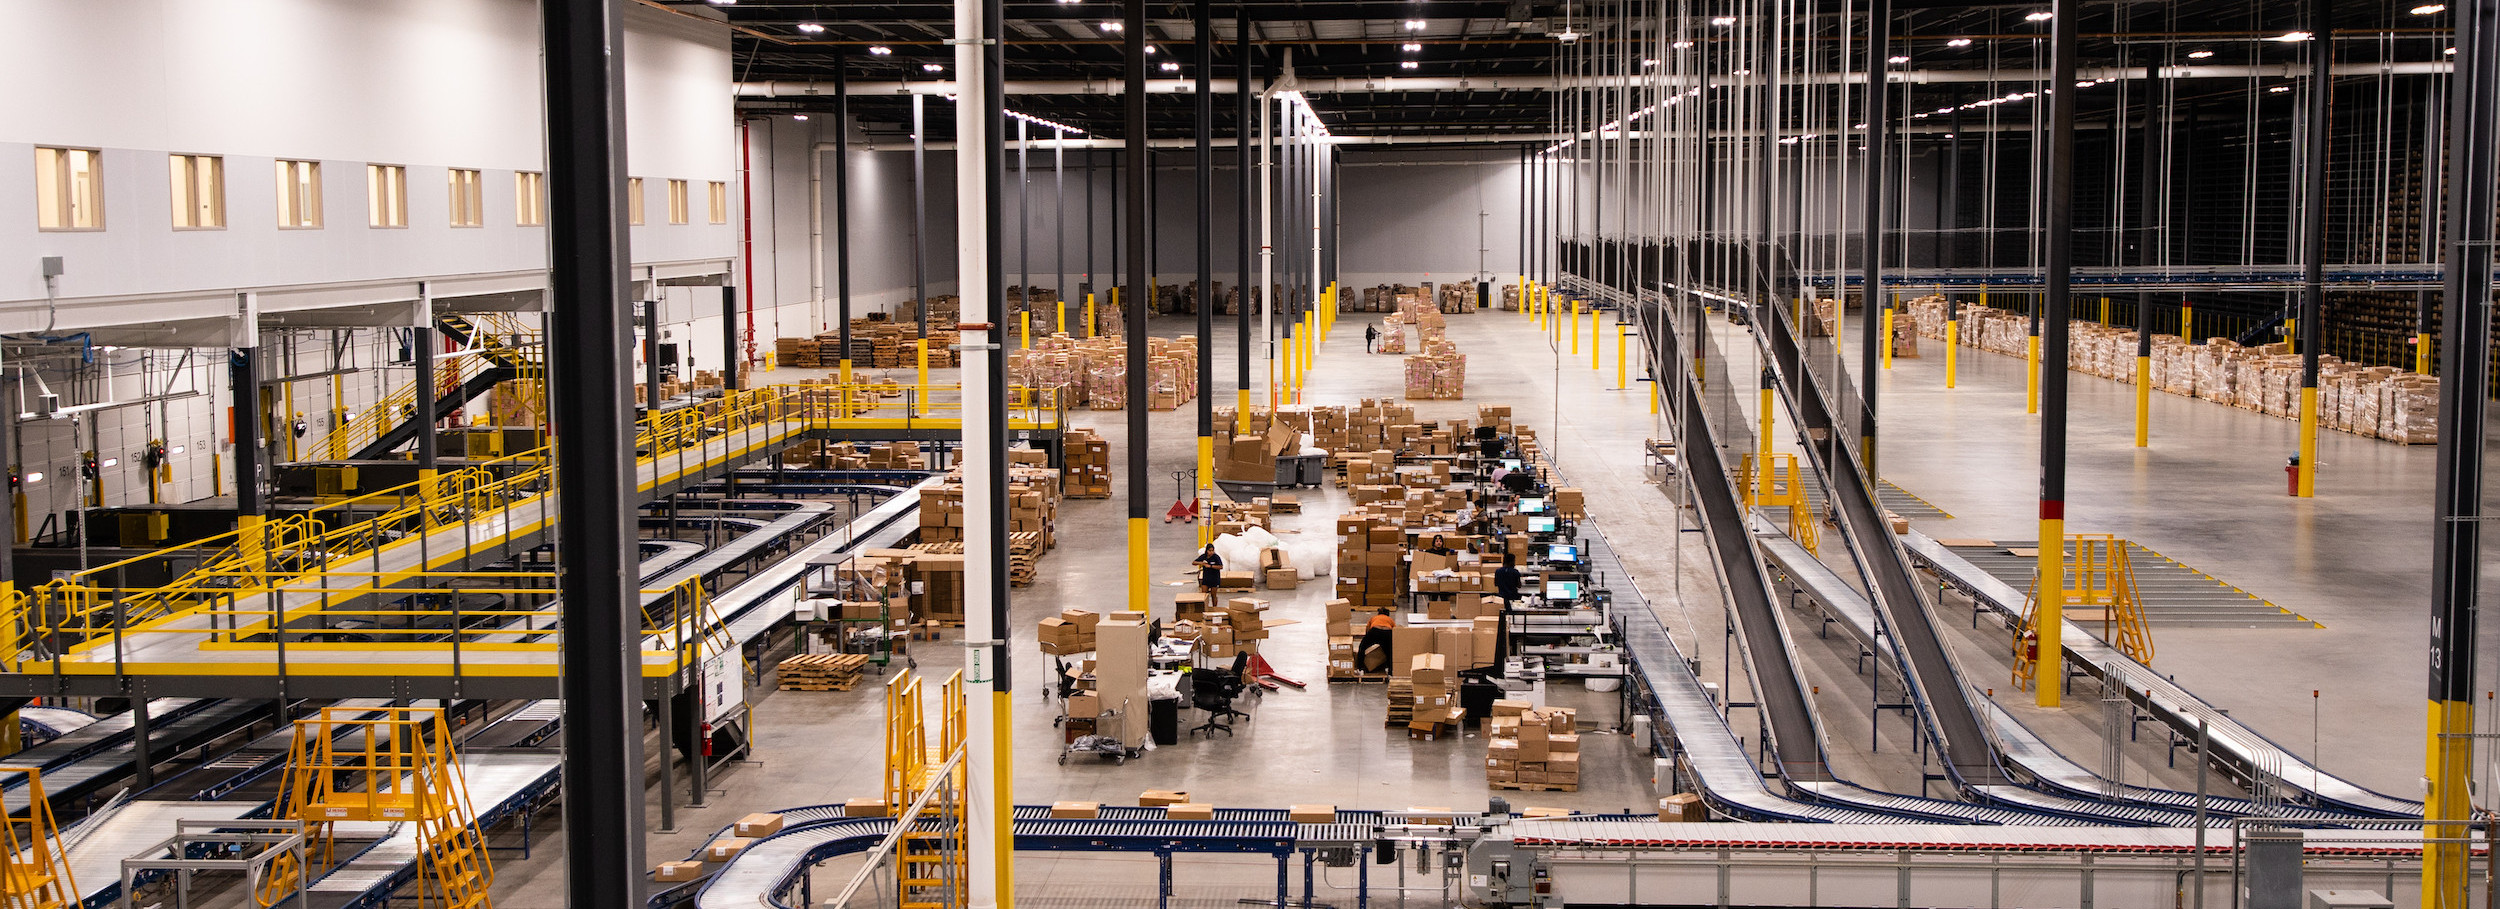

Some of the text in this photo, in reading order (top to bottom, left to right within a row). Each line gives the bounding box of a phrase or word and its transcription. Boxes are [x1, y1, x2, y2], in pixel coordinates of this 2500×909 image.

[316, 417, 325, 427] 155
[196, 439, 206, 451] 153
[130, 451, 141, 463] 152
[59, 465, 70, 477] 151
[256, 464, 262, 477] P
[255, 481, 265, 495] 14
[2432, 615, 2442, 639] M
[2430, 645, 2442, 669] 13
